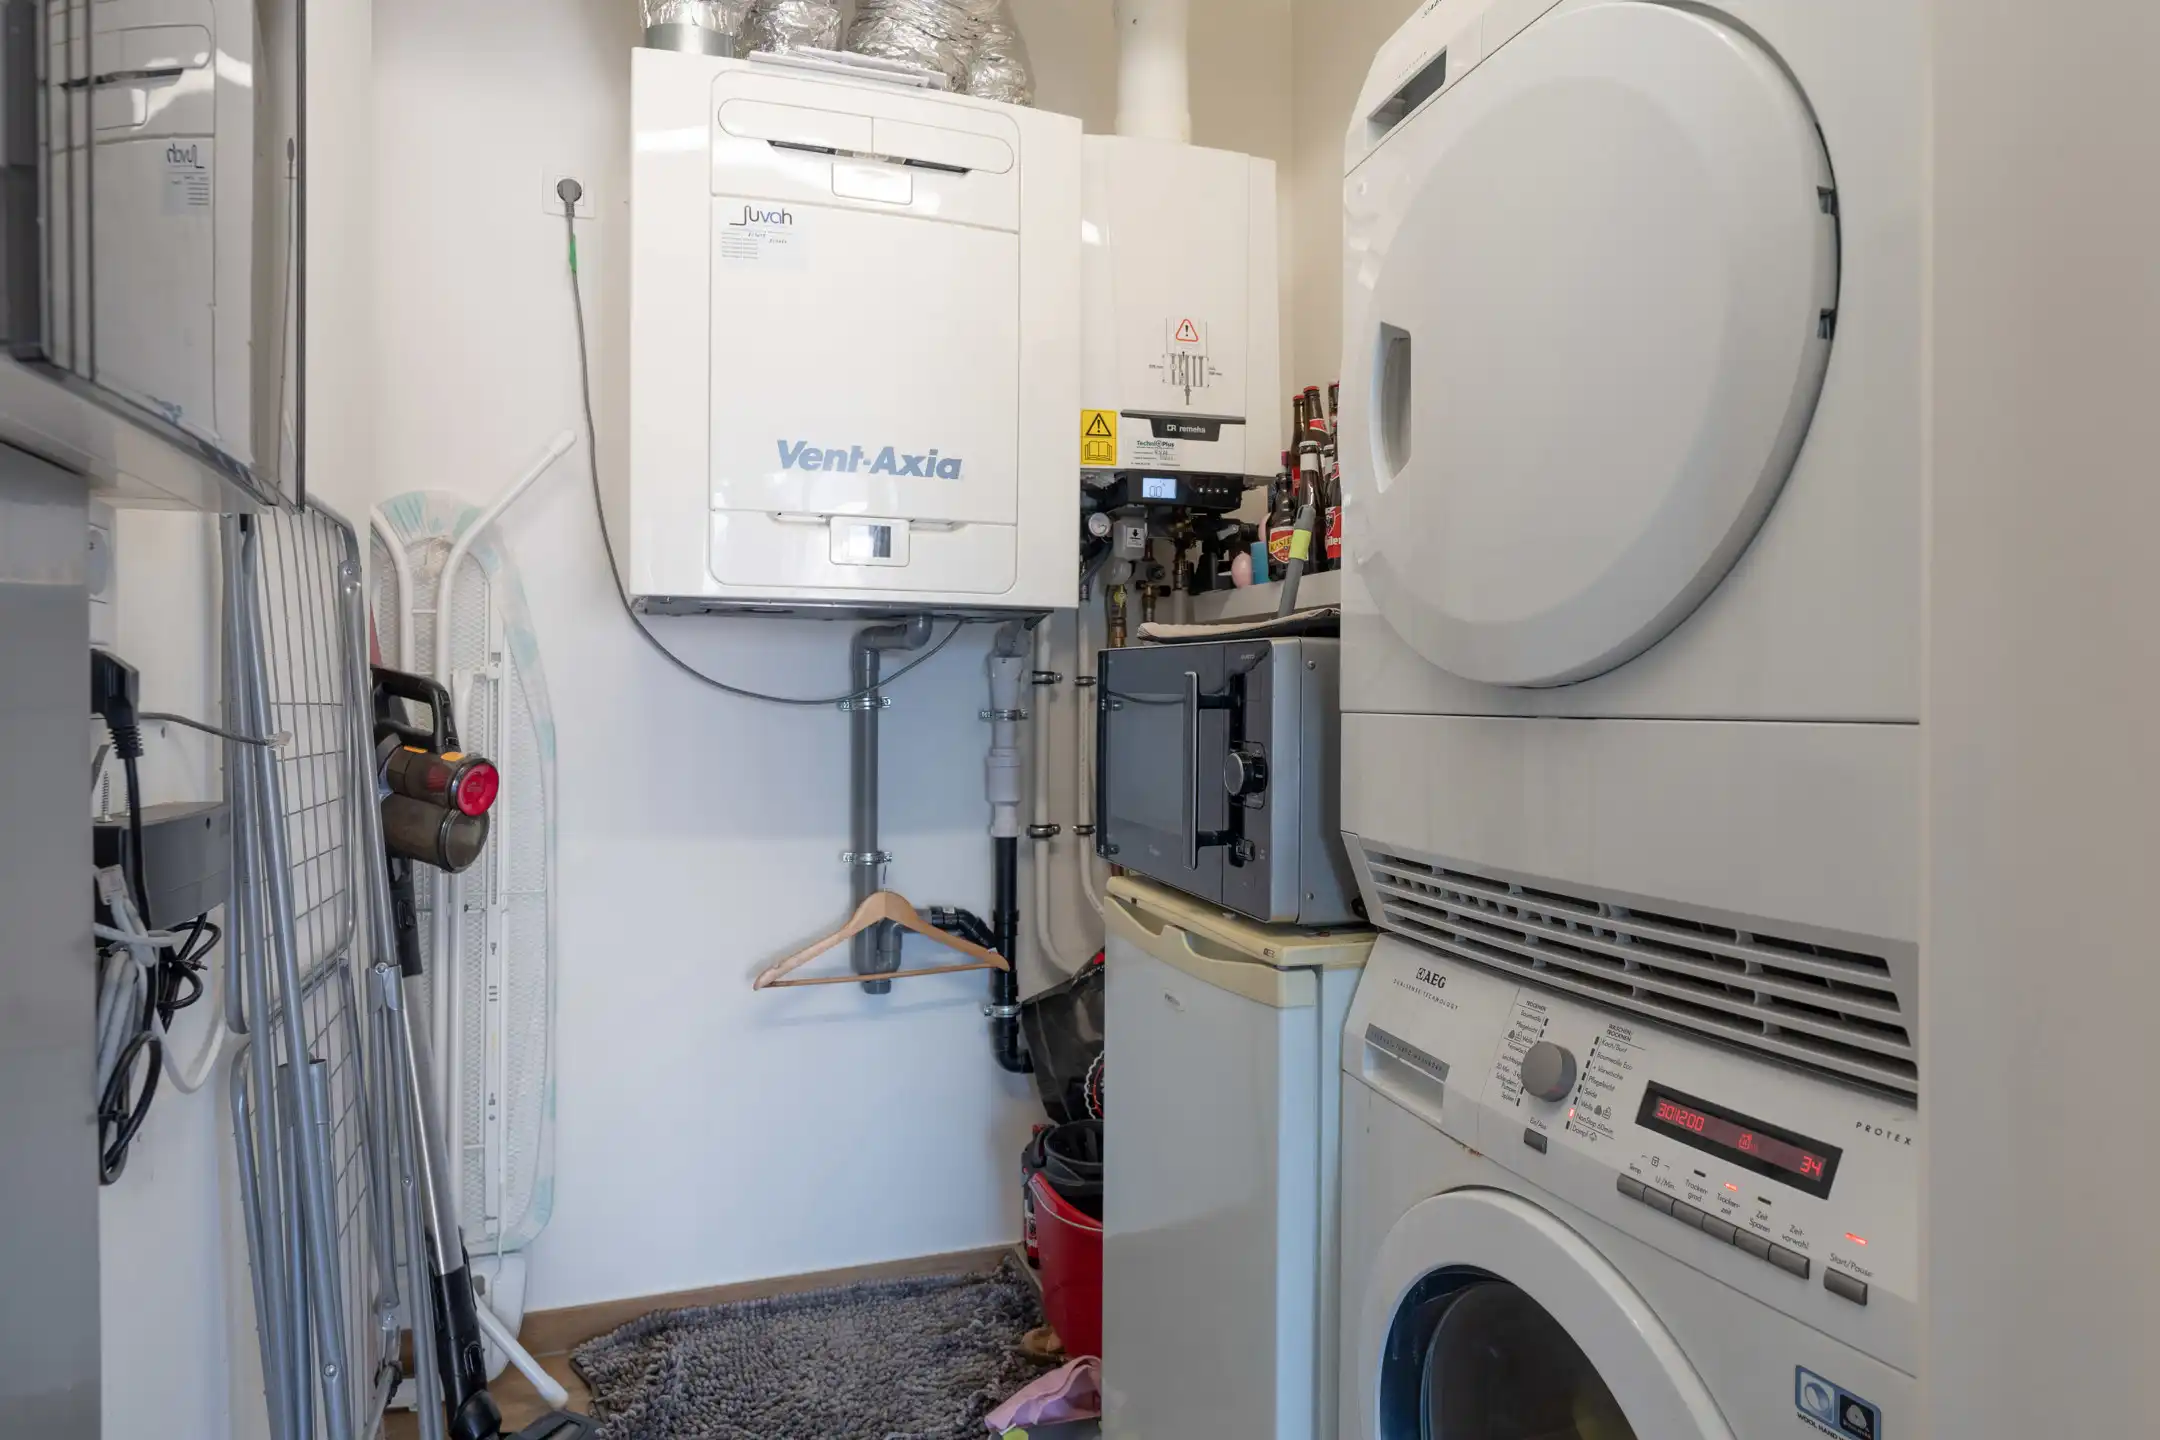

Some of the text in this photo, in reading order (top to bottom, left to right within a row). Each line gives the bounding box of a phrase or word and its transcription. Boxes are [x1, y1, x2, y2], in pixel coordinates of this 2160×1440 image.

[776, 439, 963, 480] Vent-Axia
[1422, 969, 1447, 989] AEG
[1856, 1121, 1912, 1146] PROTEX
[1800, 1155, 1823, 1177] 34
[1748, 1217, 1771, 1233] Sparen
[1829, 1252, 1874, 1277] Start/Pause
[1797, 1411, 1818, 1429] WOOL
